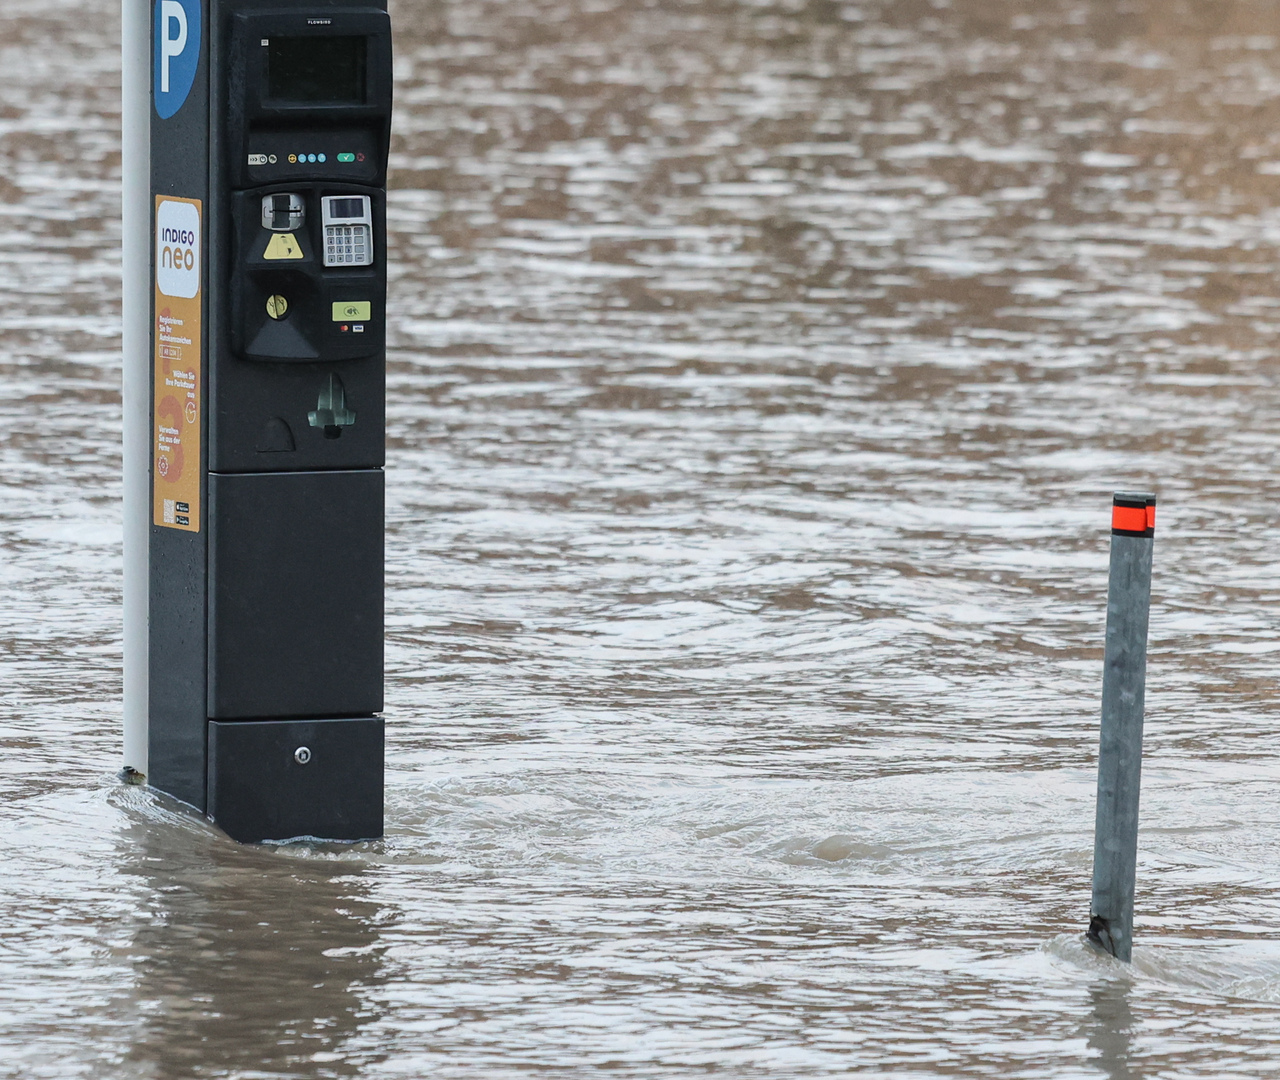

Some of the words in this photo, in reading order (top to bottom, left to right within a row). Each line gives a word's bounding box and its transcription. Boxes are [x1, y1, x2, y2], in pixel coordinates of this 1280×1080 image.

[160, 0, 188, 93] P
[162, 227, 195, 247] INDIGO
[162, 245, 195, 271] neo
